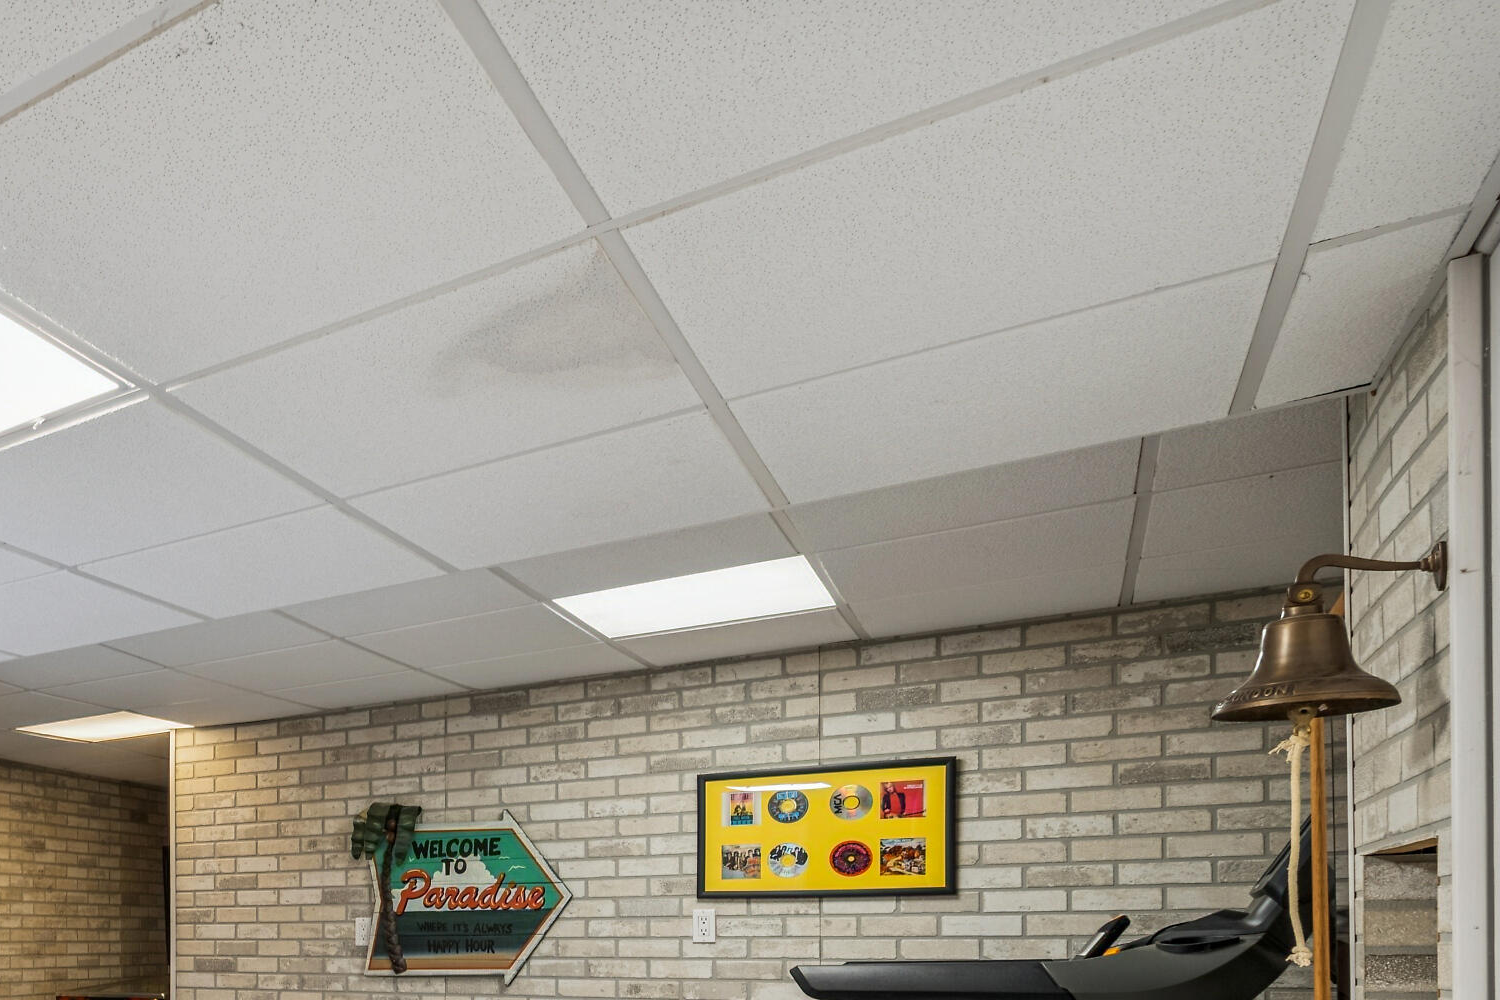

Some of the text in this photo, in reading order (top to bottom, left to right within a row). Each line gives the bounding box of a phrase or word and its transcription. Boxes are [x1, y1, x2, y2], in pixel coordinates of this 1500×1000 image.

[411, 837, 501, 860] WELCOME
[441, 858, 467, 876] TO
[395, 868, 546, 916] Paradise
[416, 921, 514, 935] WHERE IT'S ALWAYS
[427, 938, 496, 955] HAPPY HOUR
